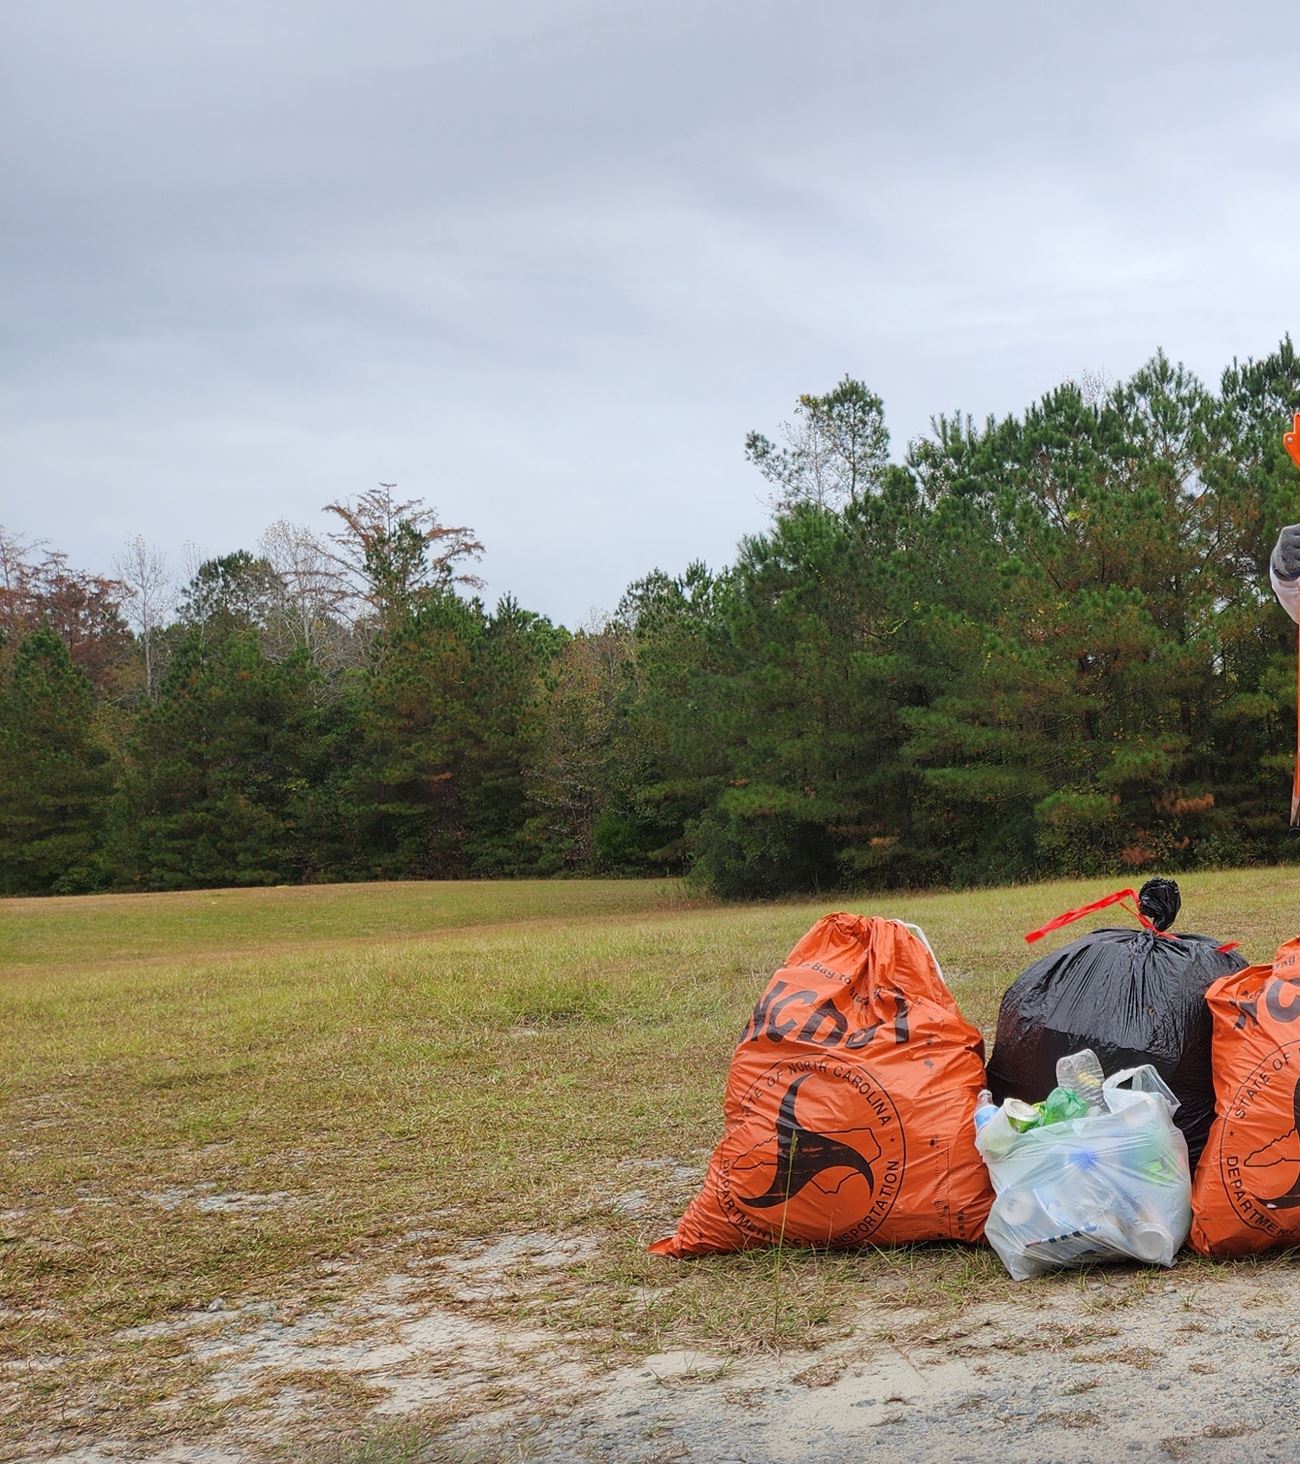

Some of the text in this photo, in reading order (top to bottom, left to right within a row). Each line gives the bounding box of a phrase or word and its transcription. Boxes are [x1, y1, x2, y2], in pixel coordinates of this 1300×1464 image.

[766, 1060, 891, 1127] OF NORTH CAROLINA
[1234, 1072, 1271, 1120] STATE
[1272, 1052, 1291, 1071] OF
